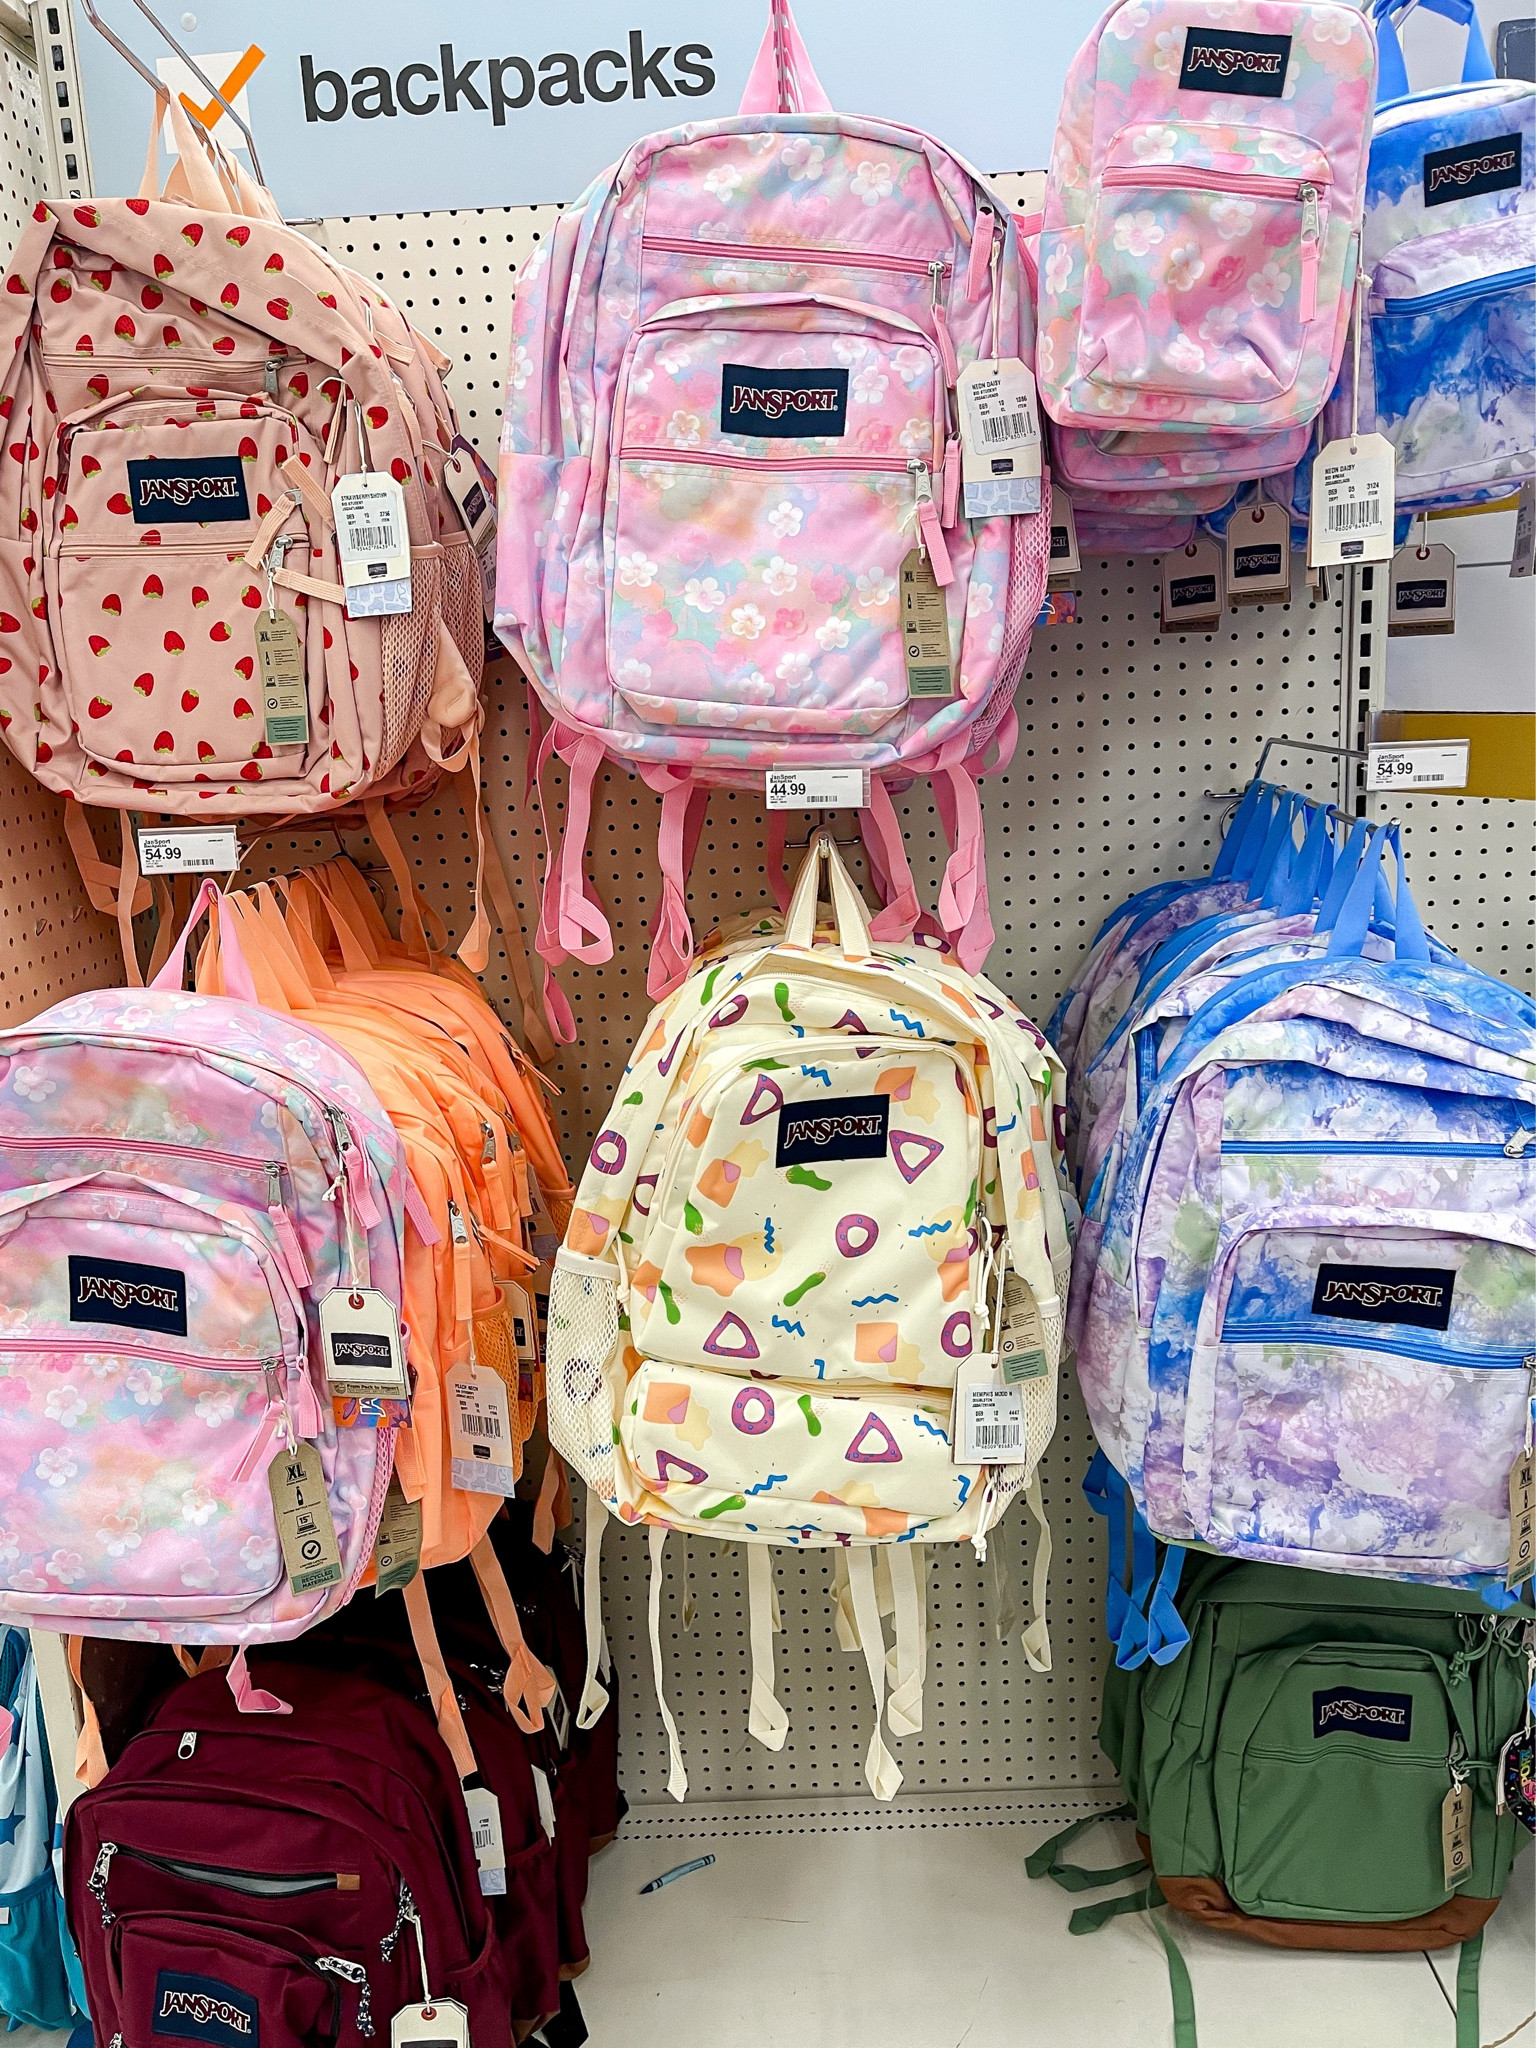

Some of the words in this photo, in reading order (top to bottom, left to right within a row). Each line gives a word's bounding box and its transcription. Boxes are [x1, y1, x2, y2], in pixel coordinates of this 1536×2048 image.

[1187, 47, 1281, 76] JANSPORT
[300, 29, 716, 126] backpacks
[1430, 150, 1516, 192] JANSPORT
[972, 382, 985, 390] NEON
[986, 380, 1001, 388] DAISY
[730, 386, 838, 419] JANSPORT
[140, 476, 236, 506] JANSPORT
[1398, 588, 1445, 603] JANSPORT
[1377, 762, 1413, 775] 54.99
[770, 783, 806, 795] 44.99
[145, 847, 181, 860] 54.99
[784, 1115, 882, 1149] JANSPORT
[78, 1276, 177, 1310] JANSPORT
[1322, 1281, 1443, 1306] JANSPORT
[335, 1343, 389, 1357] JANSPORT
[286, 1463, 306, 1479] XL
[1520, 1468, 1532, 1484] XL
[301, 1570, 333, 1584] RECYCLED
[303, 1575, 334, 1589] MATERIALS
[1320, 1700, 1405, 1725] JANSPORT
[160, 1990, 250, 2033] JANSPORT
